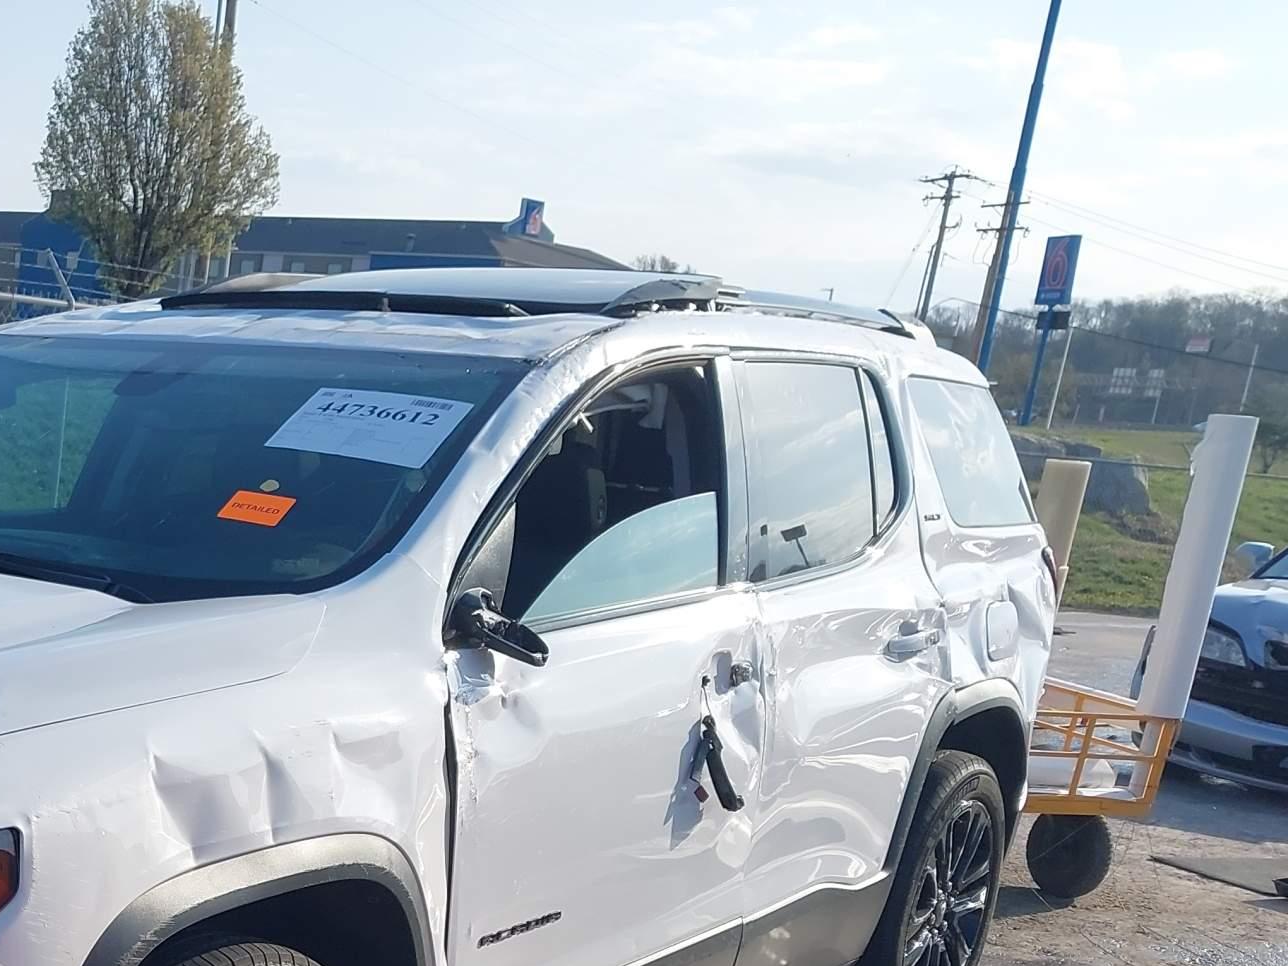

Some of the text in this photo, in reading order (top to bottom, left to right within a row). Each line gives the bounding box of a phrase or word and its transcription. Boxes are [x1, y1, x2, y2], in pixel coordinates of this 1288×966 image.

[1045, 237, 1070, 289] 6
[317, 401, 440, 426] 44736612
[231, 501, 281, 515] DETAILED
